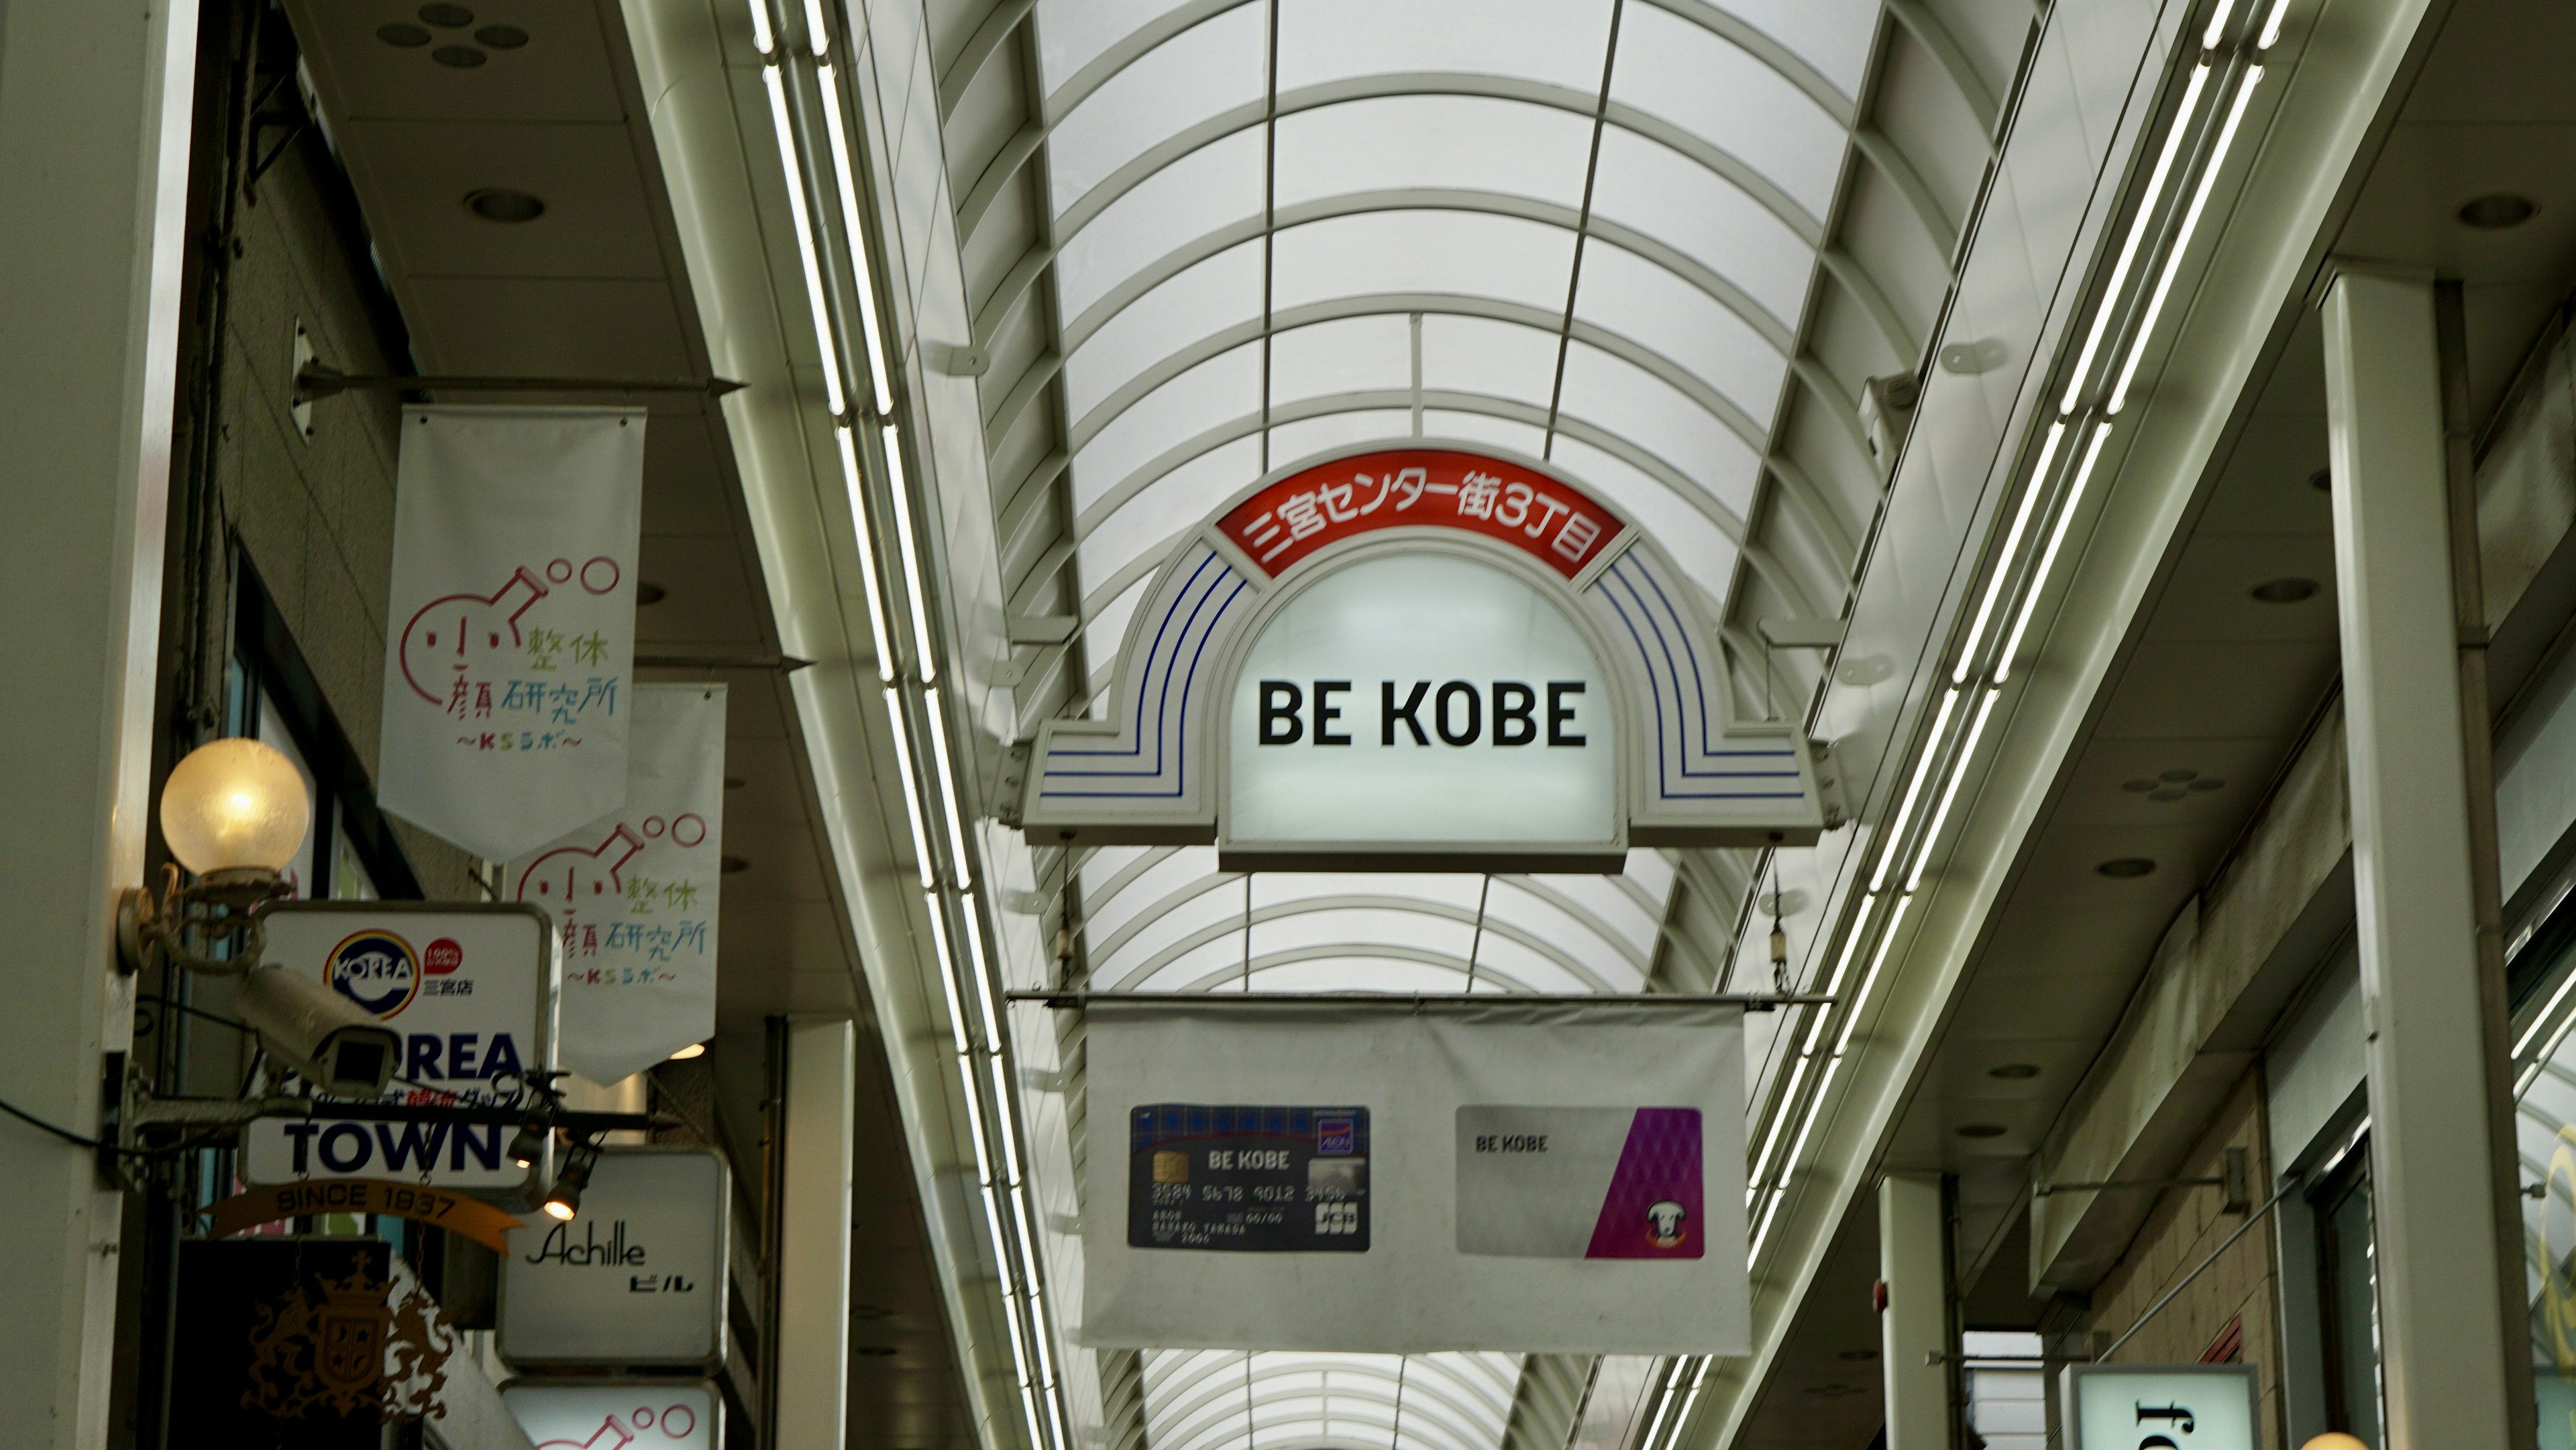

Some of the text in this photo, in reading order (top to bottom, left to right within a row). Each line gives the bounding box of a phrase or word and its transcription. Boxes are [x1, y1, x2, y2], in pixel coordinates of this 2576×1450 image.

[1243, 466, 1602, 564] 三宮センター街3丁目
[446, 673, 621, 725] 顔研究所
[1258, 679, 1587, 747] BE KOBE
[332, 956, 414, 980] KOREA
[423, 978, 474, 996] 三宮店
[397, 1031, 523, 1080] REA
[283, 1120, 502, 1172] TOWN
[1476, 1135, 1548, 1153] BE KOBE
[1208, 1149, 1290, 1170] BE KOBE
[276, 1184, 368, 1212] SINCE
[1202, 1185, 1244, 1202] 5678
[1253, 1185, 1295, 1202] 9012
[525, 1220, 645, 1267] Achille
[629, 1274, 694, 1293] ビル
